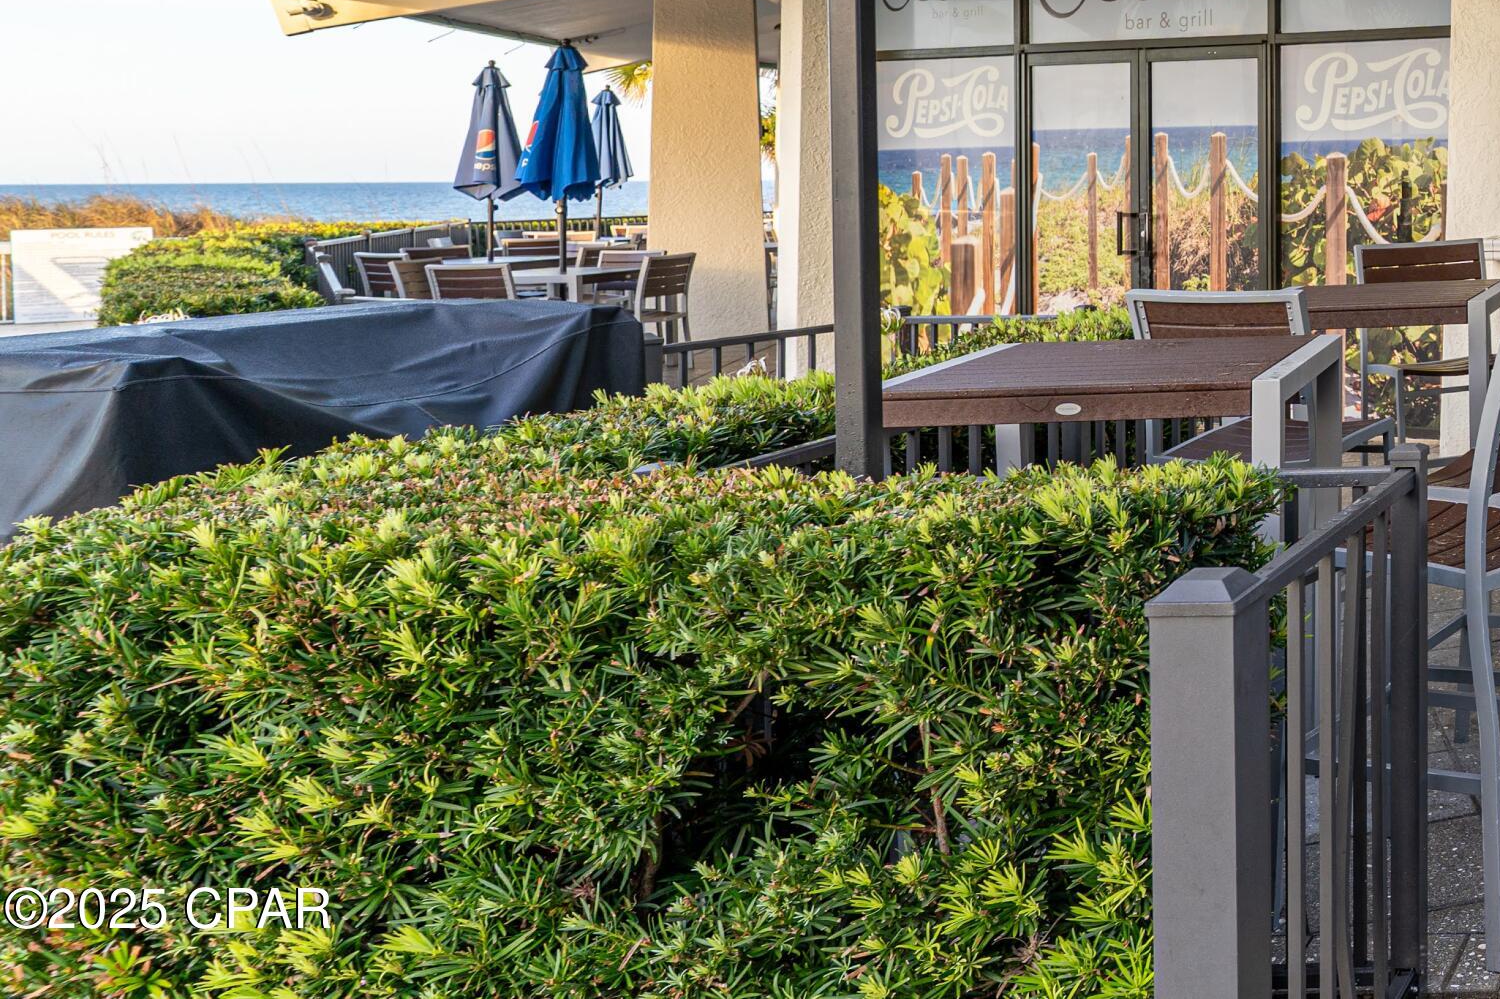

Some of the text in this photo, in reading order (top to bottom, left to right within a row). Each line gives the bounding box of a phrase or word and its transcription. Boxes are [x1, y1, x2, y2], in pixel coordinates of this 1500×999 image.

[932, 6, 984, 20] bar & grill
[1125, 9, 1213, 32] bar & grill
[886, 65, 1009, 138] PEPSI-COLA
[1296, 48, 1450, 131] PEPSI-COLA
